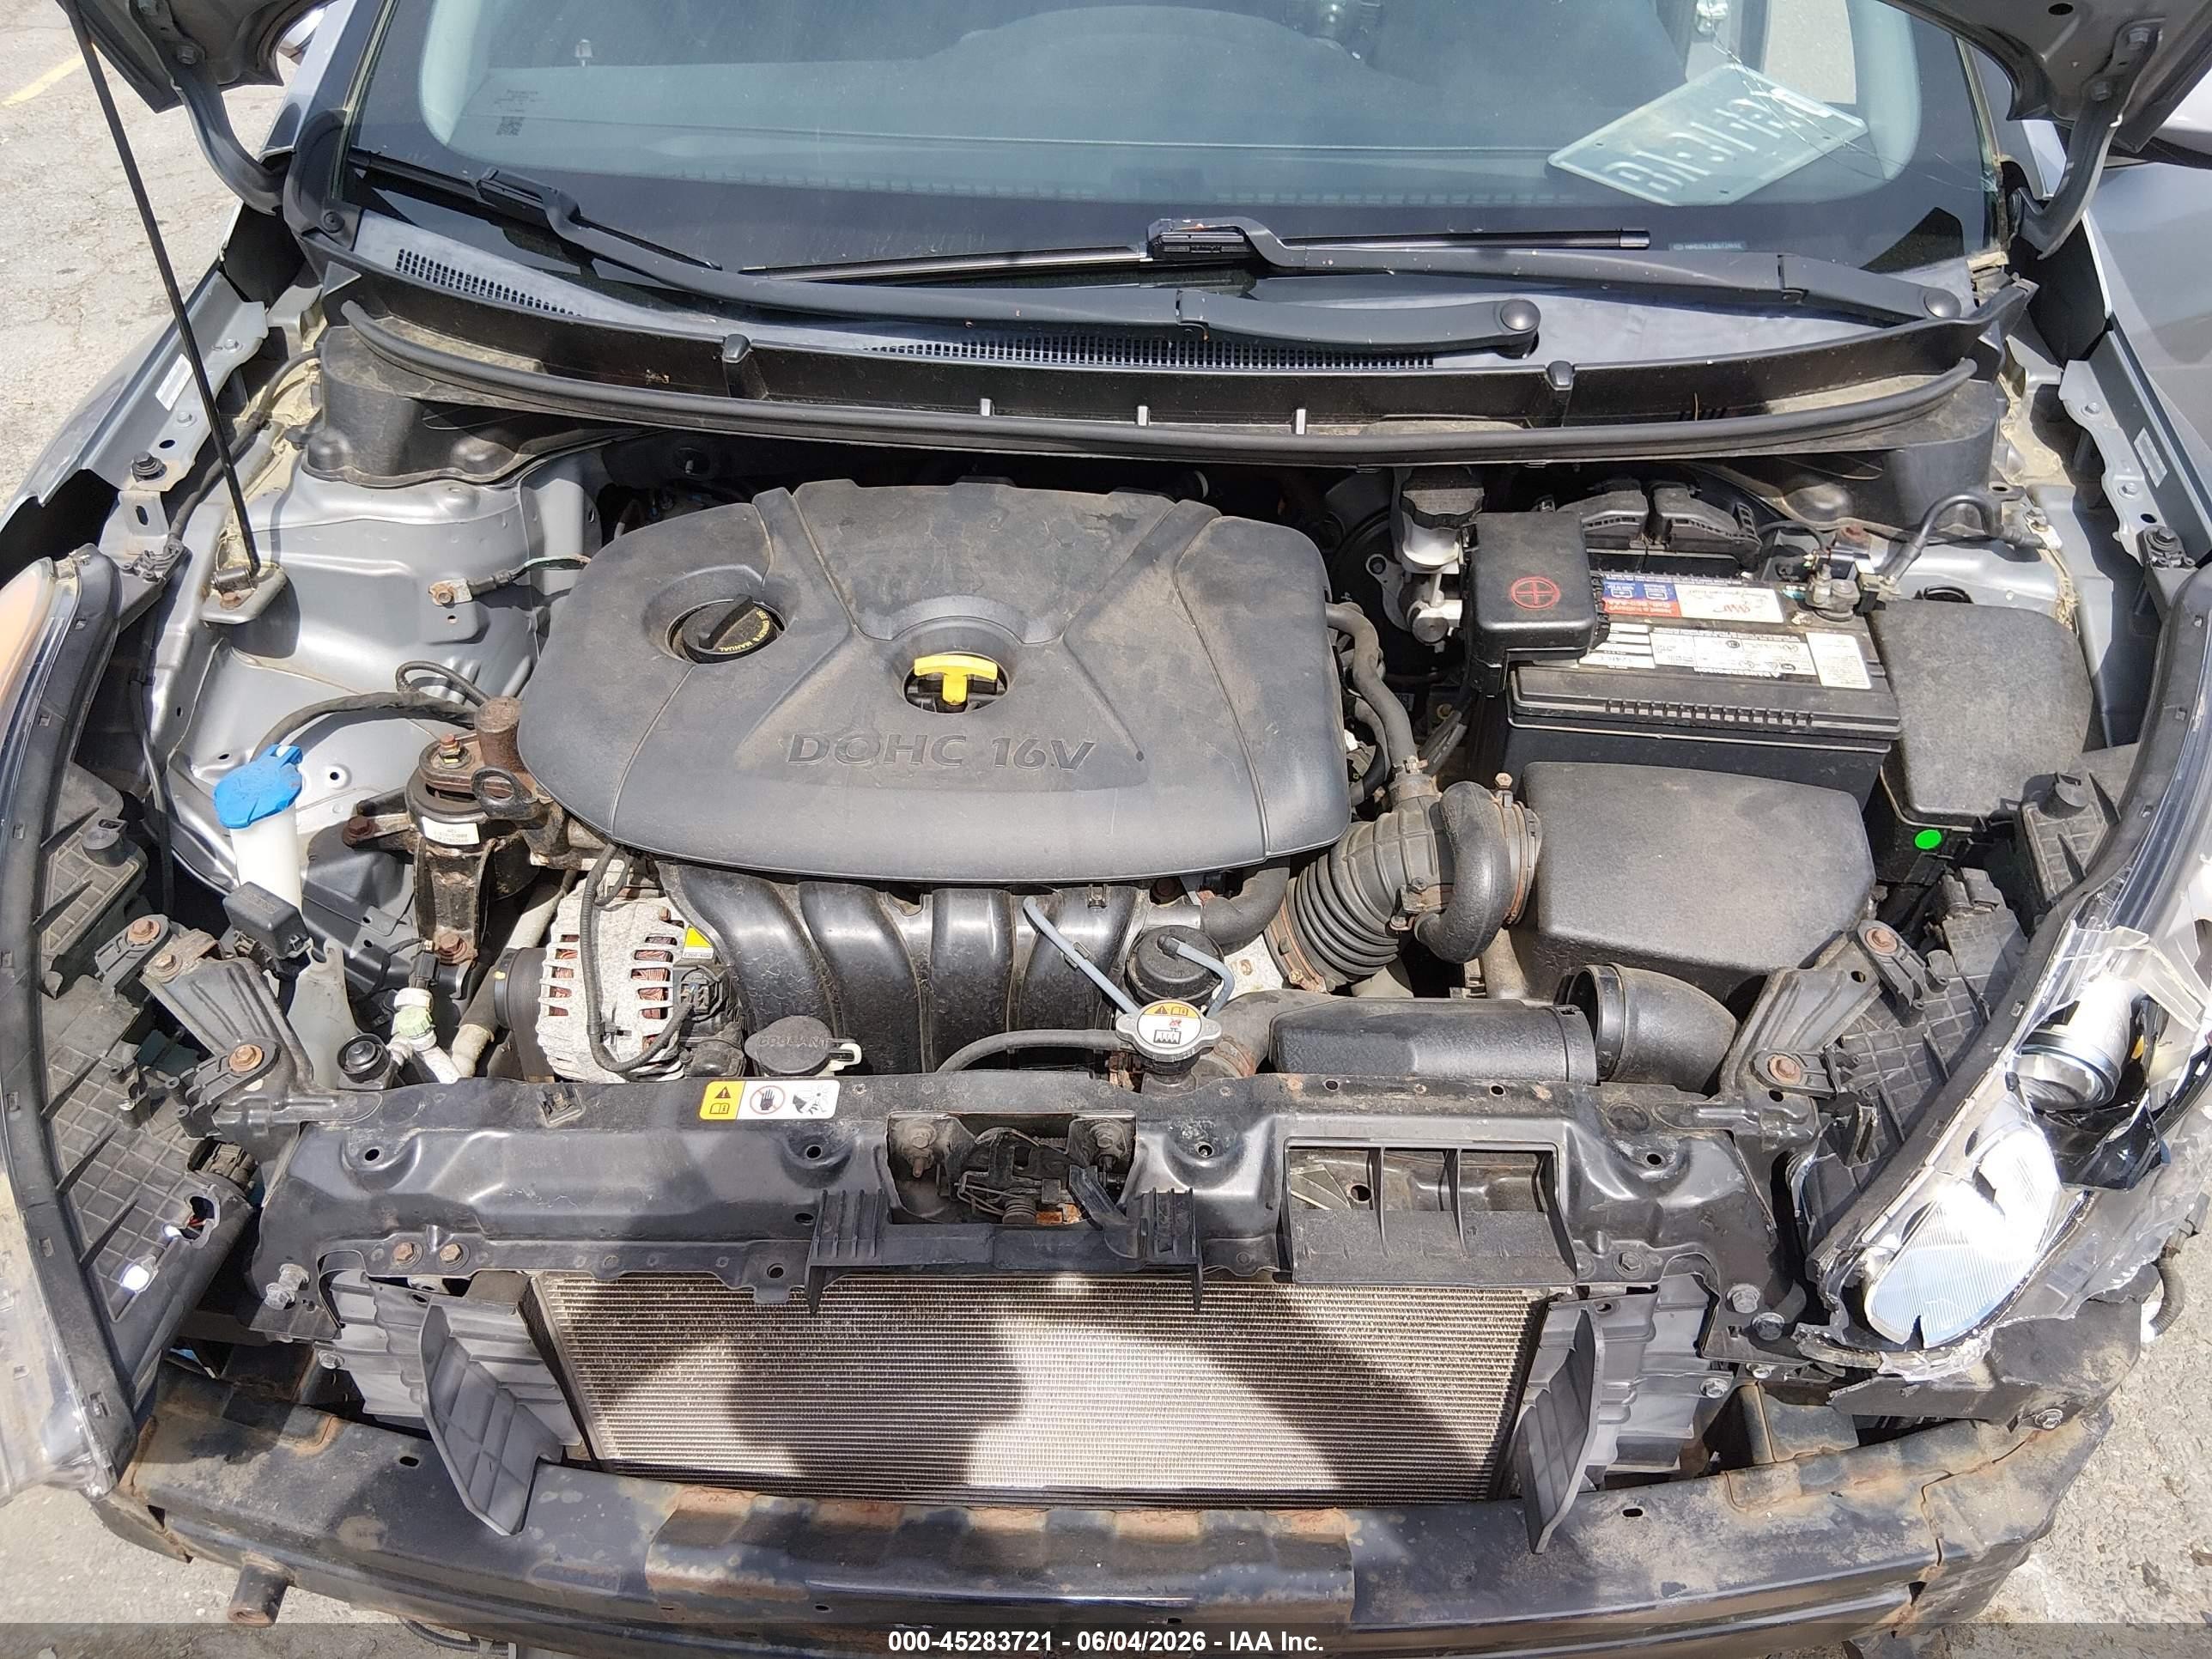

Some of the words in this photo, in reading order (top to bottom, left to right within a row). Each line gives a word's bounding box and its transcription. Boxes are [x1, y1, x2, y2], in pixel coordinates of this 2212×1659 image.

[756, 611, 769, 620] SEE
[718, 641, 753, 653] MANUAL
[787, 733, 967, 767] DOHC
[991, 737, 1095, 771] 16V
[758, 1036, 830, 1048] COOLANT
